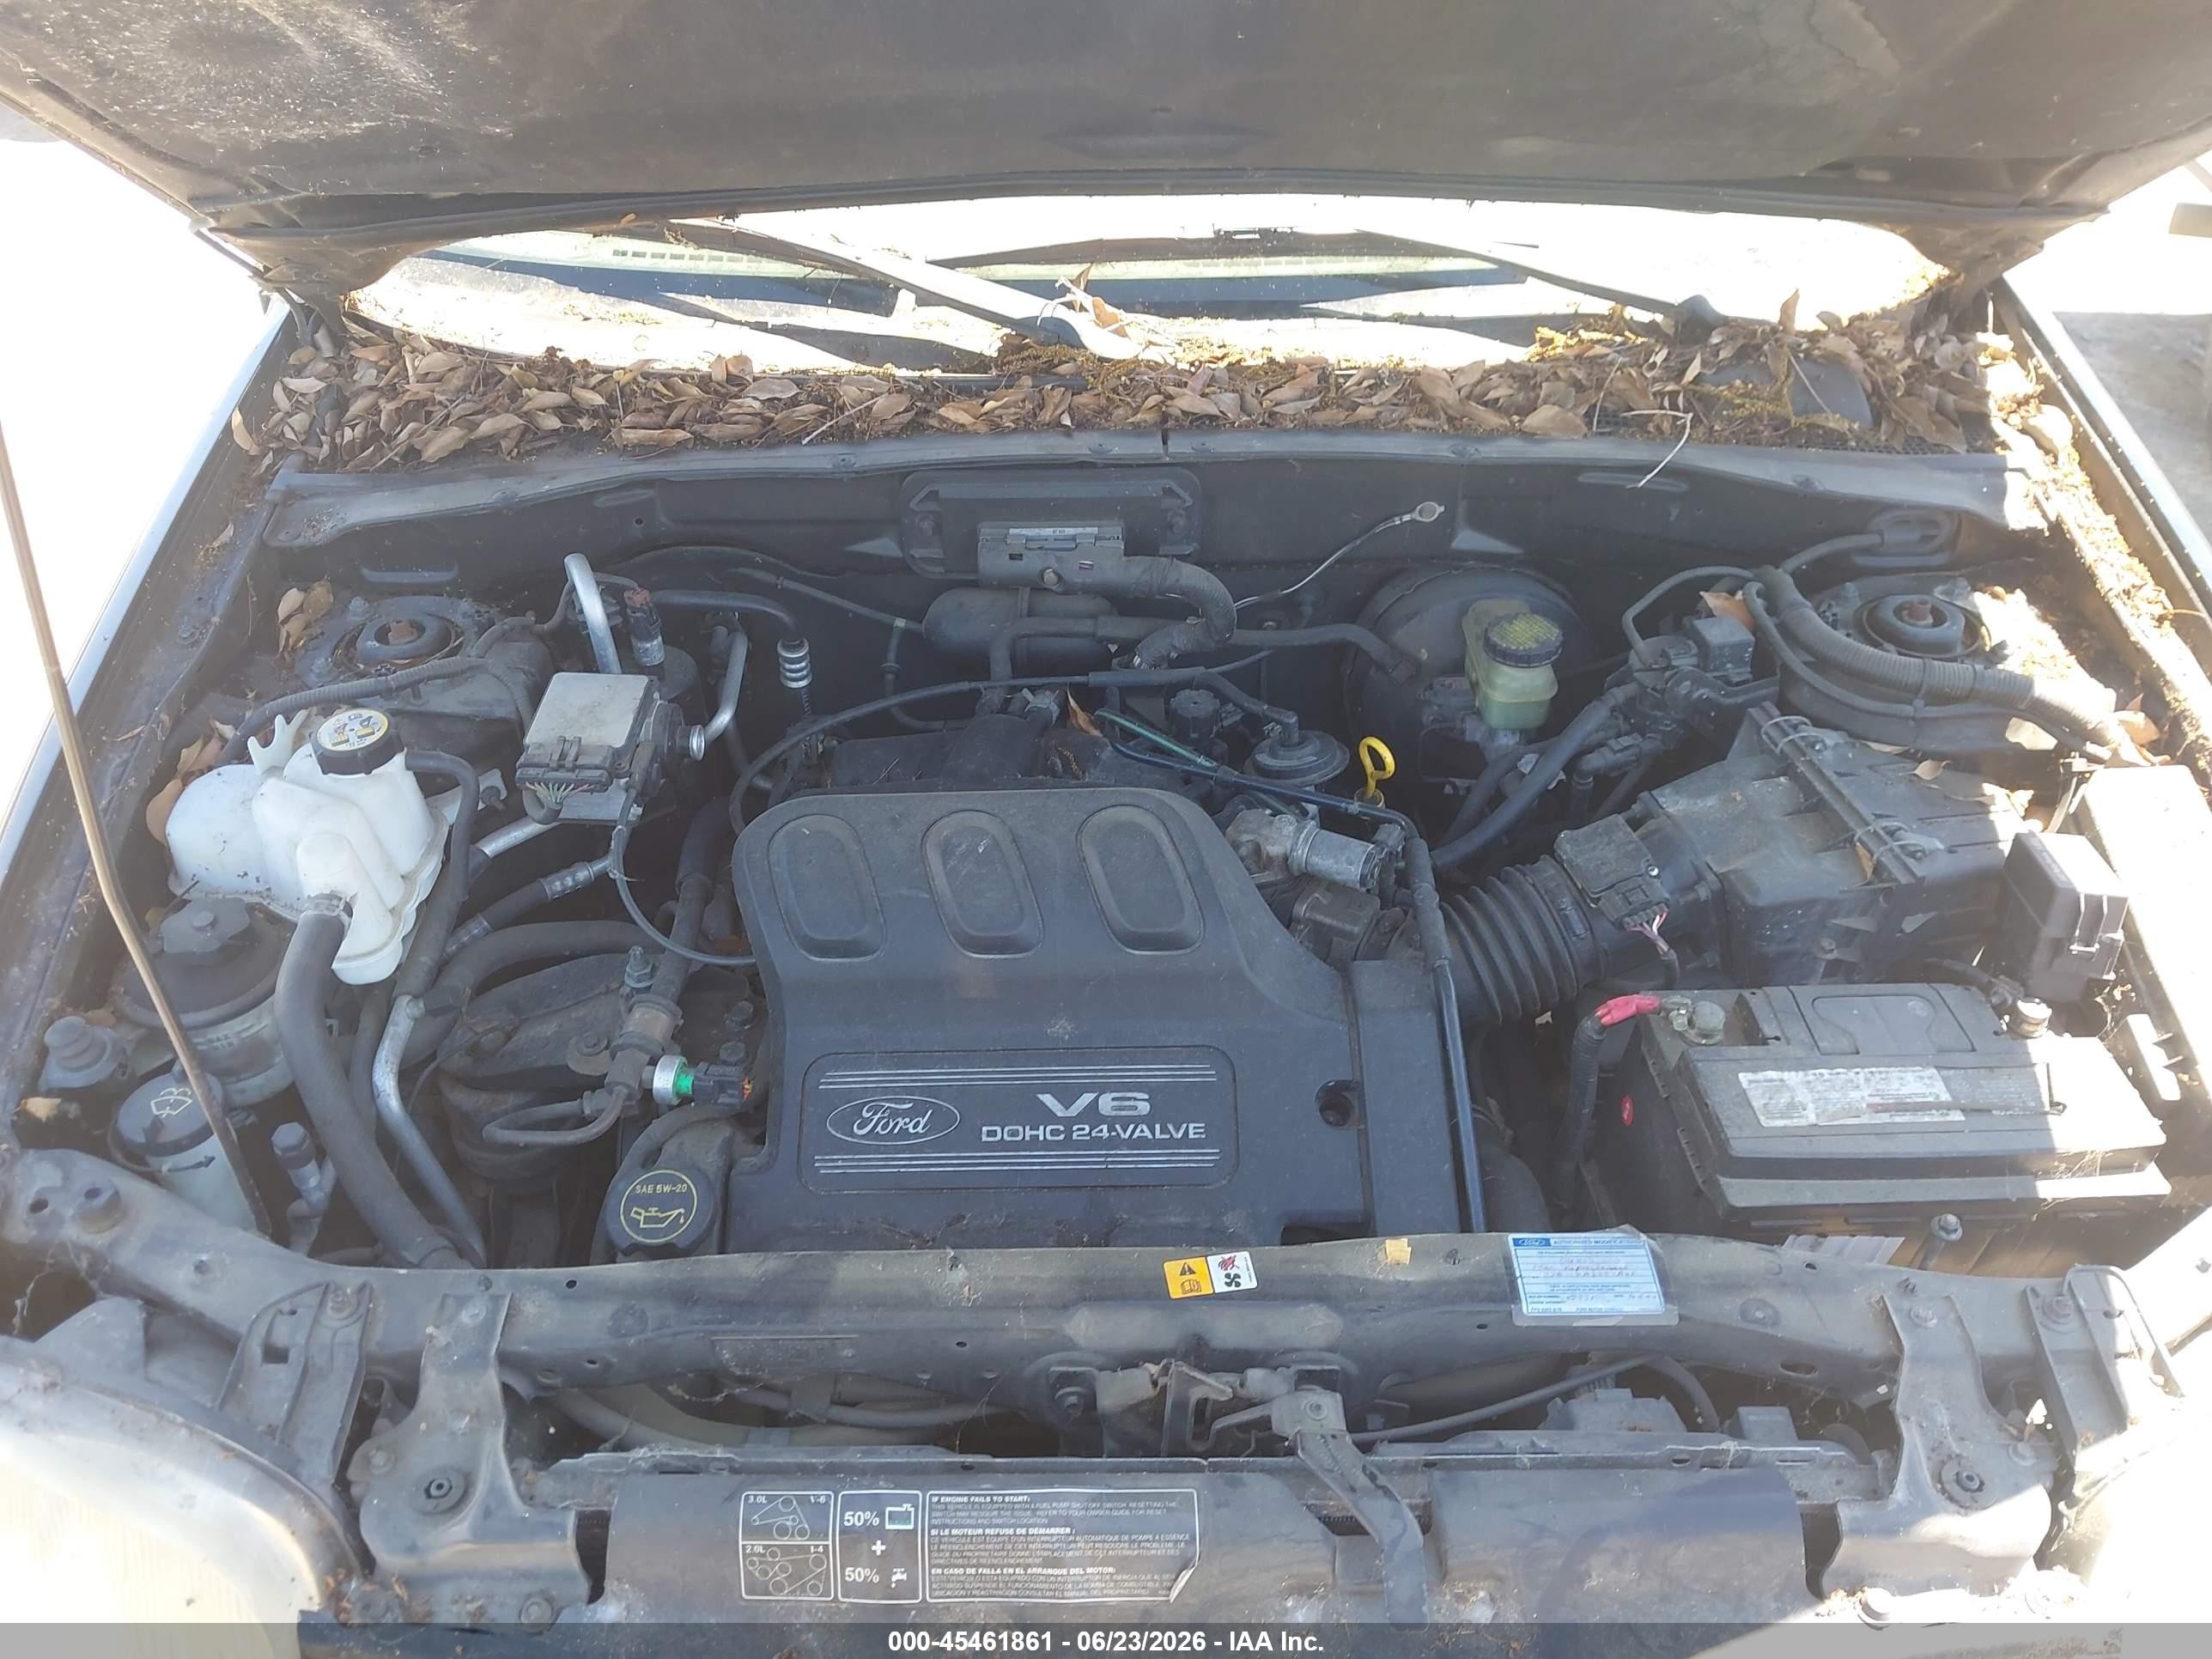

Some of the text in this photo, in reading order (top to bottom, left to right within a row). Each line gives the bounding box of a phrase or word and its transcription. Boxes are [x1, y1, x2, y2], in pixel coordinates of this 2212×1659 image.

[1036, 1091, 1152, 1117] V6
[853, 1102, 933, 1136] Ford
[981, 1122, 1206, 1142] DOHC 24-VALVE
[635, 1182, 688, 1194] SAE 5W-20
[748, 1495, 768, 1504] 3.0L
[843, 1510, 880, 1527] 50%
[745, 1545, 766, 1554] 2.0L
[844, 1566, 880, 1583] 50%
